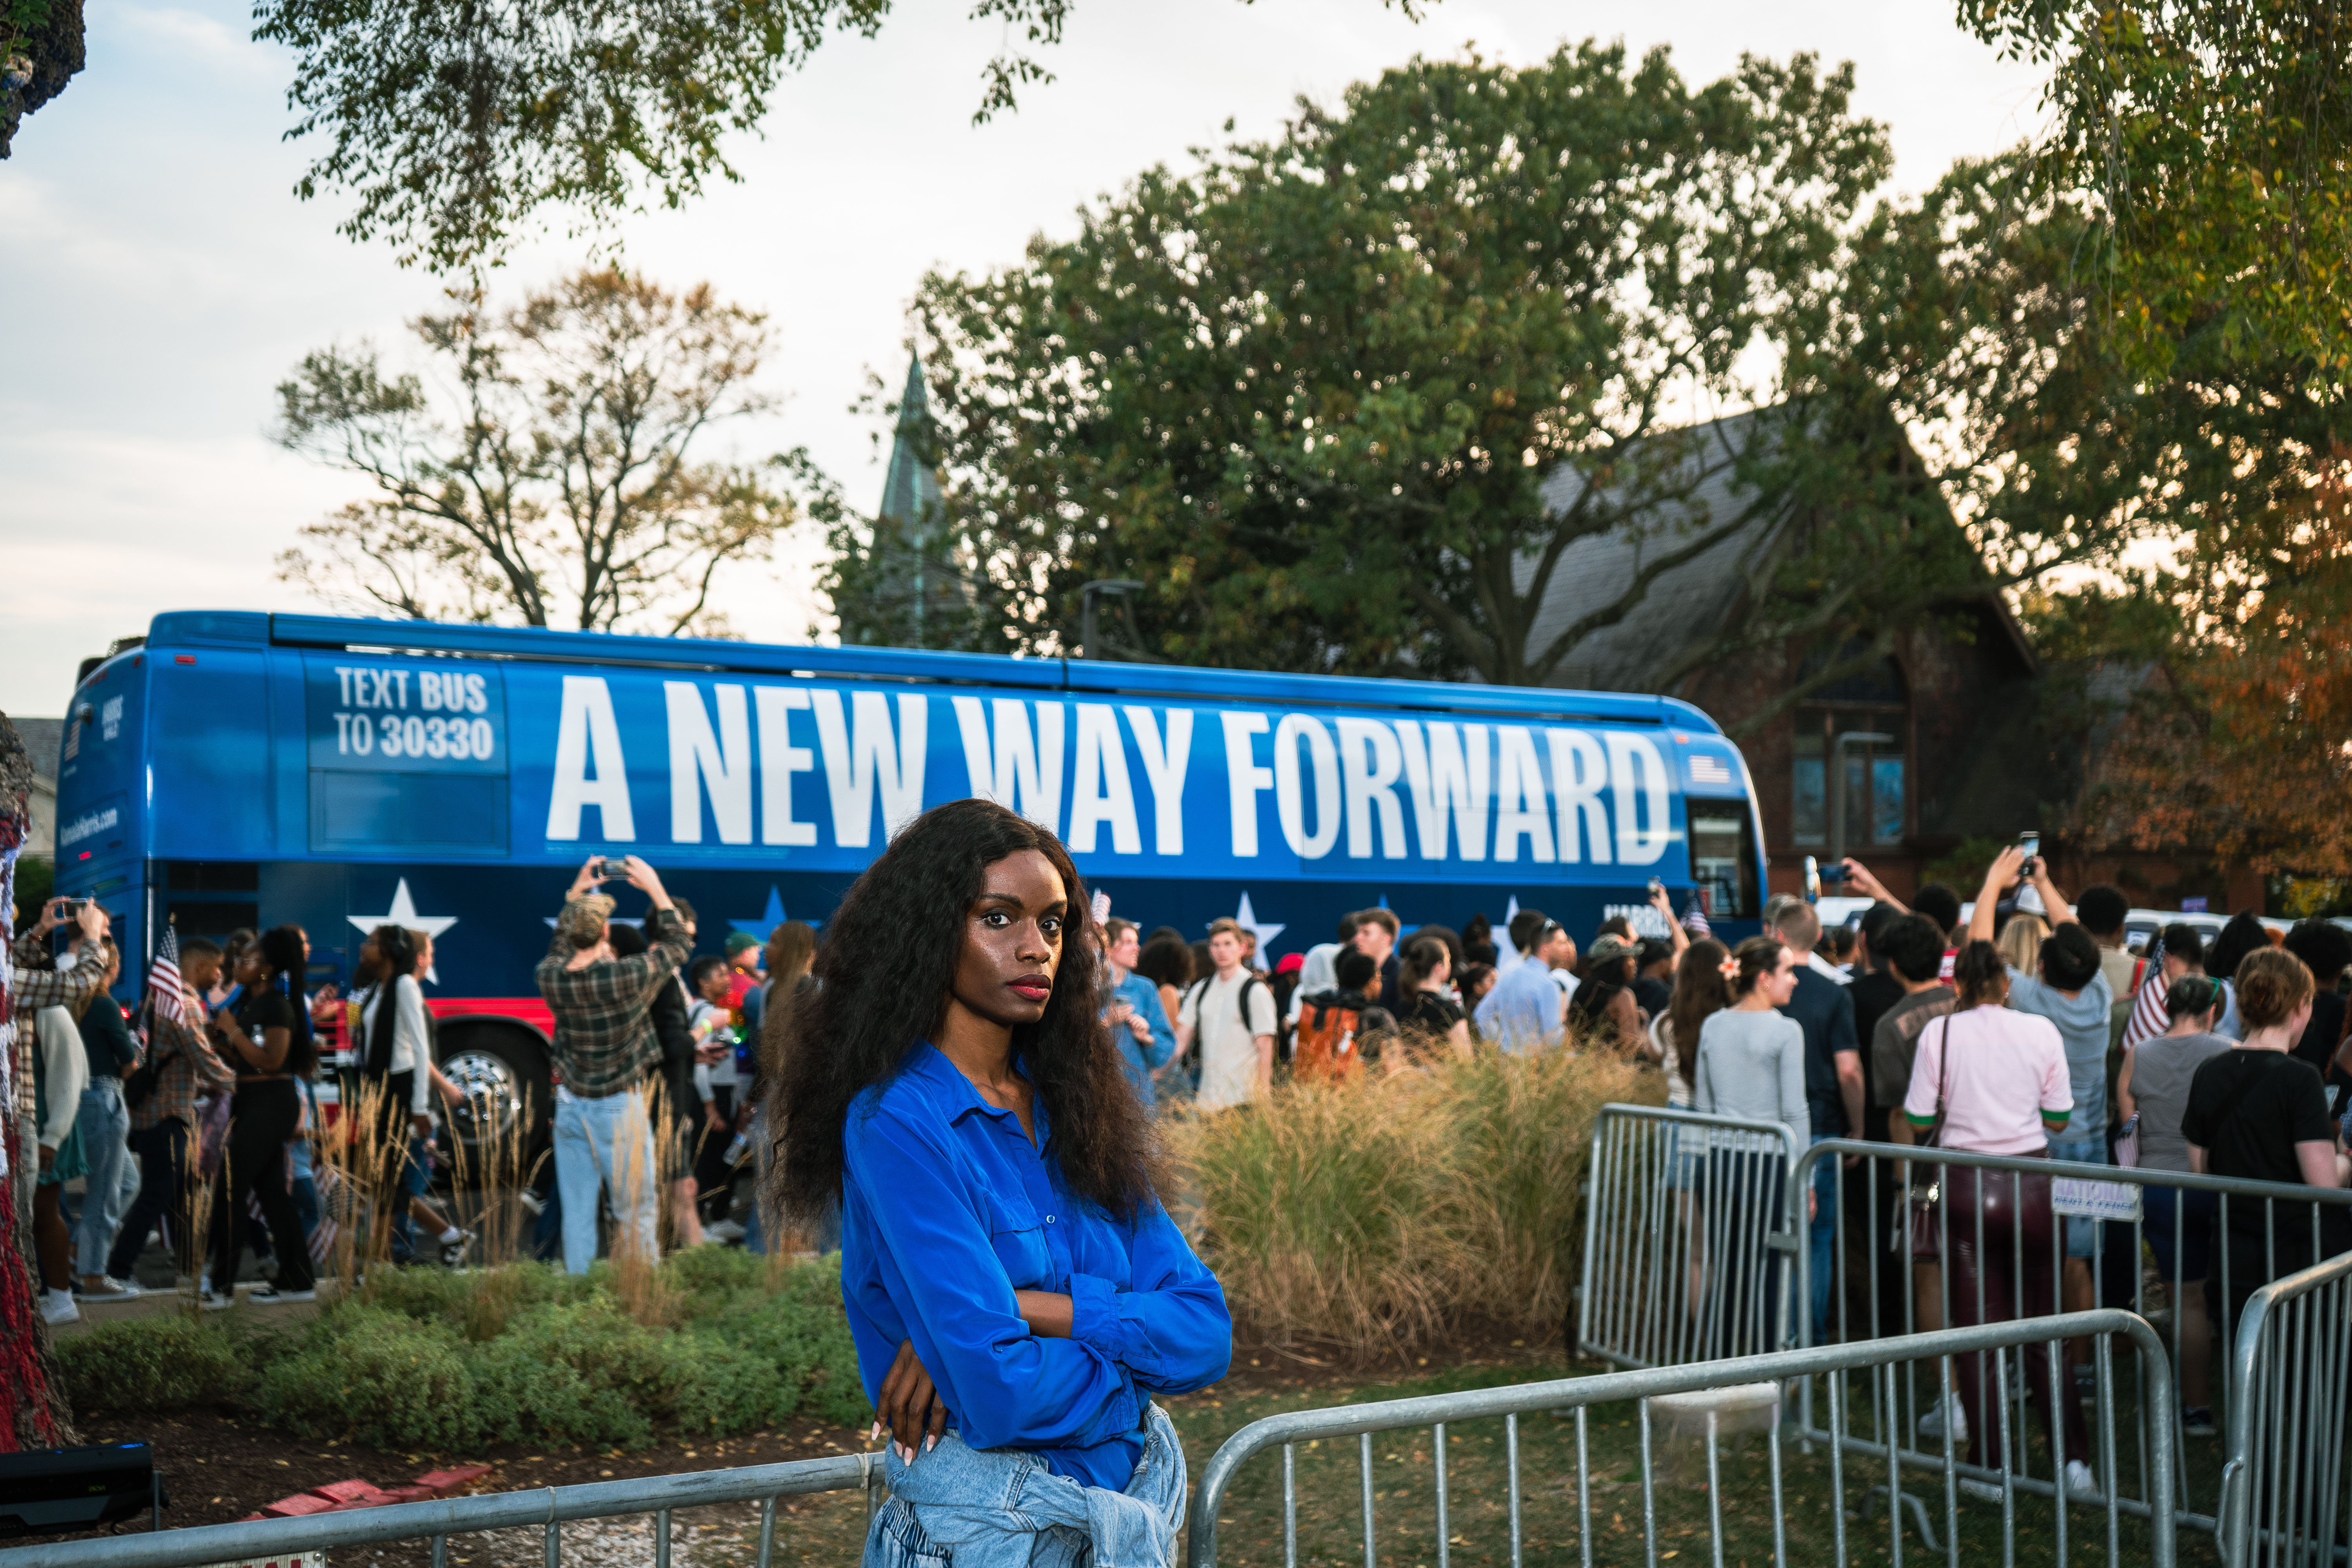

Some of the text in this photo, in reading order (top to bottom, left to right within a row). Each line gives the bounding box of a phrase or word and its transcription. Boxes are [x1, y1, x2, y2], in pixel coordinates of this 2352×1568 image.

[334, 666, 488, 714] TEXT BUS
[333, 711, 494, 761] TO 30330
[546, 675, 1671, 866] A NEW WAY FORWARD
